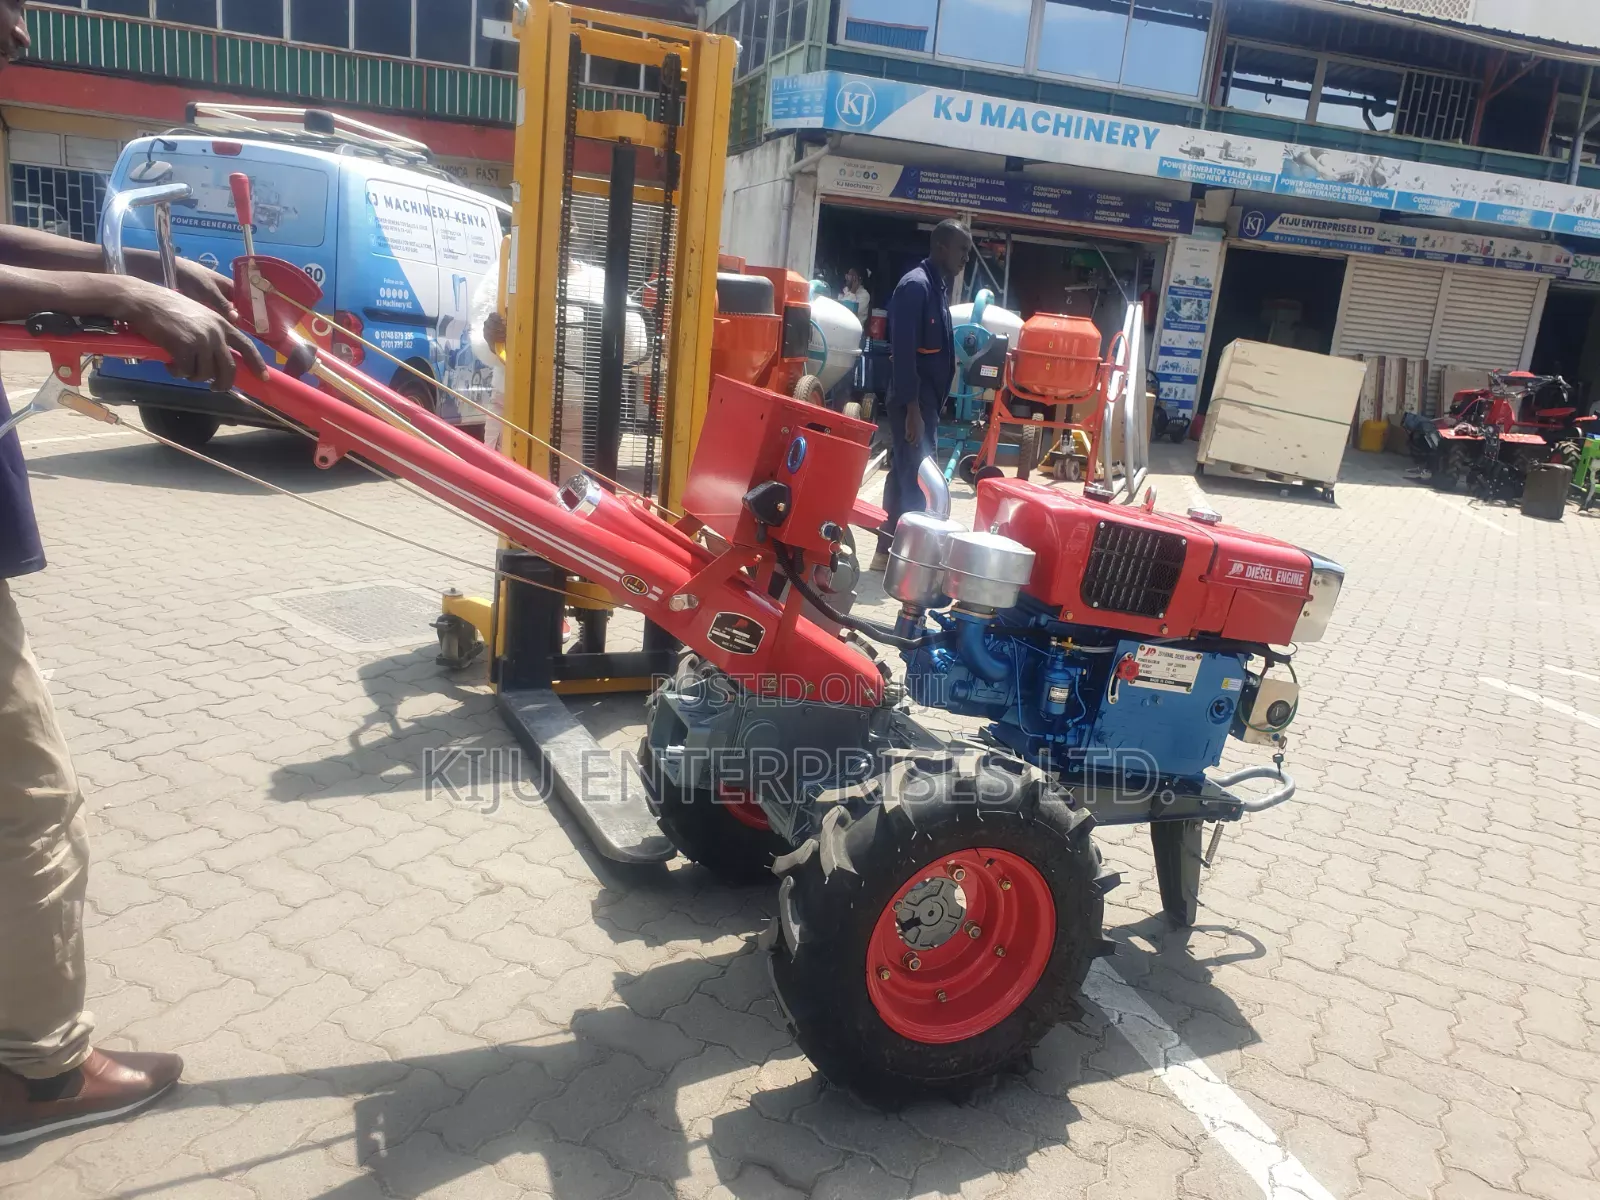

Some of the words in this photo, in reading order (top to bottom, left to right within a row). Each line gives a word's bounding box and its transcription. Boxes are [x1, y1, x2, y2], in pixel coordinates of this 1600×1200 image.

[841, 91, 871, 126] KJ
[933, 94, 973, 123] KJ
[980, 102, 1160, 150] MACHINERY
[940, 172, 970, 182] GENERATOR
[1162, 160, 1186, 170] POWER
[1187, 164, 1226, 176] GENERATOR
[1227, 169, 1245, 178] SALES
[1253, 173, 1272, 183] LEASE
[1207, 173, 1221, 182] NEW
[1034, 186, 1072, 195] CONSTRUCTION
[1280, 178, 1304, 188] POWER
[1305, 182, 1340, 192] GENERATOR
[918, 193, 955, 203] MAINTENANCE
[938, 190, 968, 198] GENERATOR
[1033, 191, 1061, 199] EQUIPMENT
[1295, 188, 1340, 199] MAINTENANCE
[1347, 194, 1372, 203] REPAIRS
[366, 192, 378, 206] KJ
[384, 196, 450, 220] MACHINERY
[455, 211, 486, 228] KENYA
[172, 216, 198, 226] POWER
[201, 220, 254, 232] GENERATO
[1246, 216, 1263, 236] KJ
[1279, 216, 1300, 226] KIJU
[1302, 219, 1356, 233] ENTERPRISES
[1358, 226, 1375, 235] LTD
[304, 267, 322, 282] 80
[383, 300, 405, 309] Machinery
[1246, 566, 1272, 581] DIESEL
[1276, 570, 1304, 585] ENGINE
